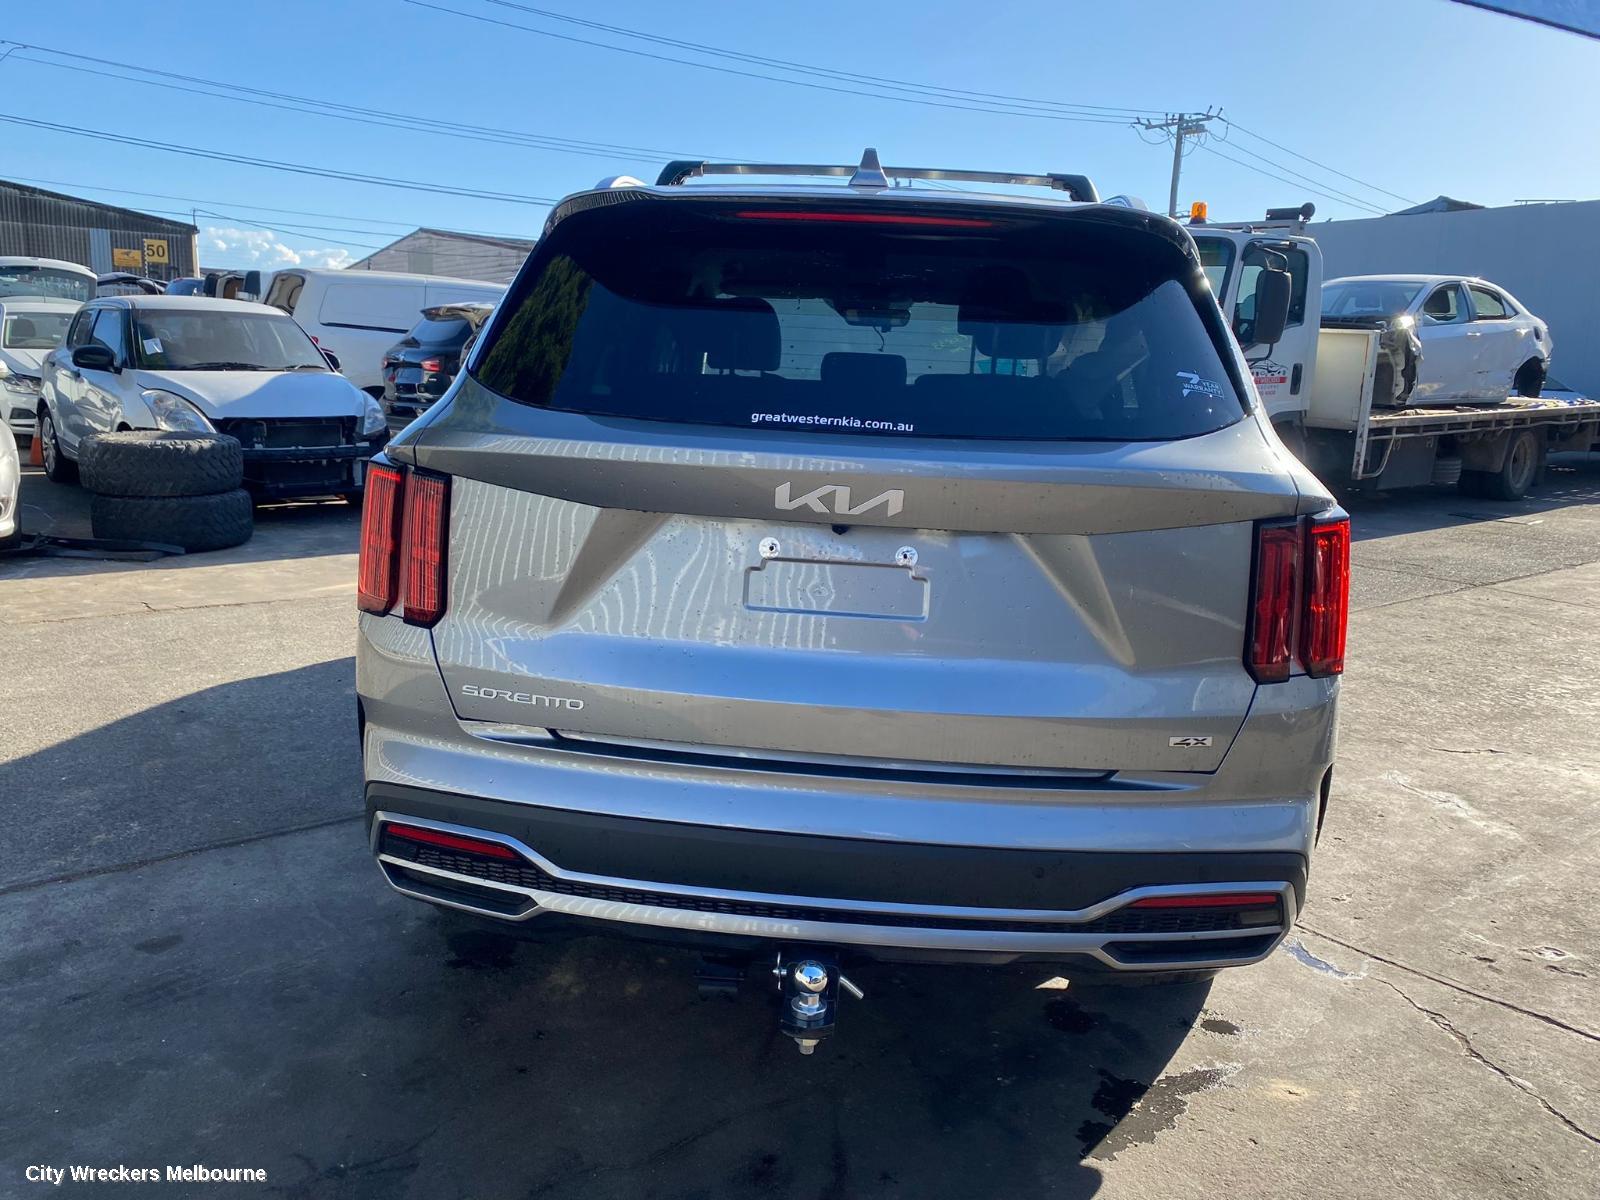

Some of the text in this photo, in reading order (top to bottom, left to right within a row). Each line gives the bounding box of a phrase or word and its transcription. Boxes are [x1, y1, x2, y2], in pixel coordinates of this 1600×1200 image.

[146, 244, 166, 258] 50
[1183, 382, 1222, 395] WARRANTY
[751, 412, 914, 432] greatwesternkia.com.au
[775, 481, 905, 517] KIA
[462, 684, 584, 710] SORENTO
